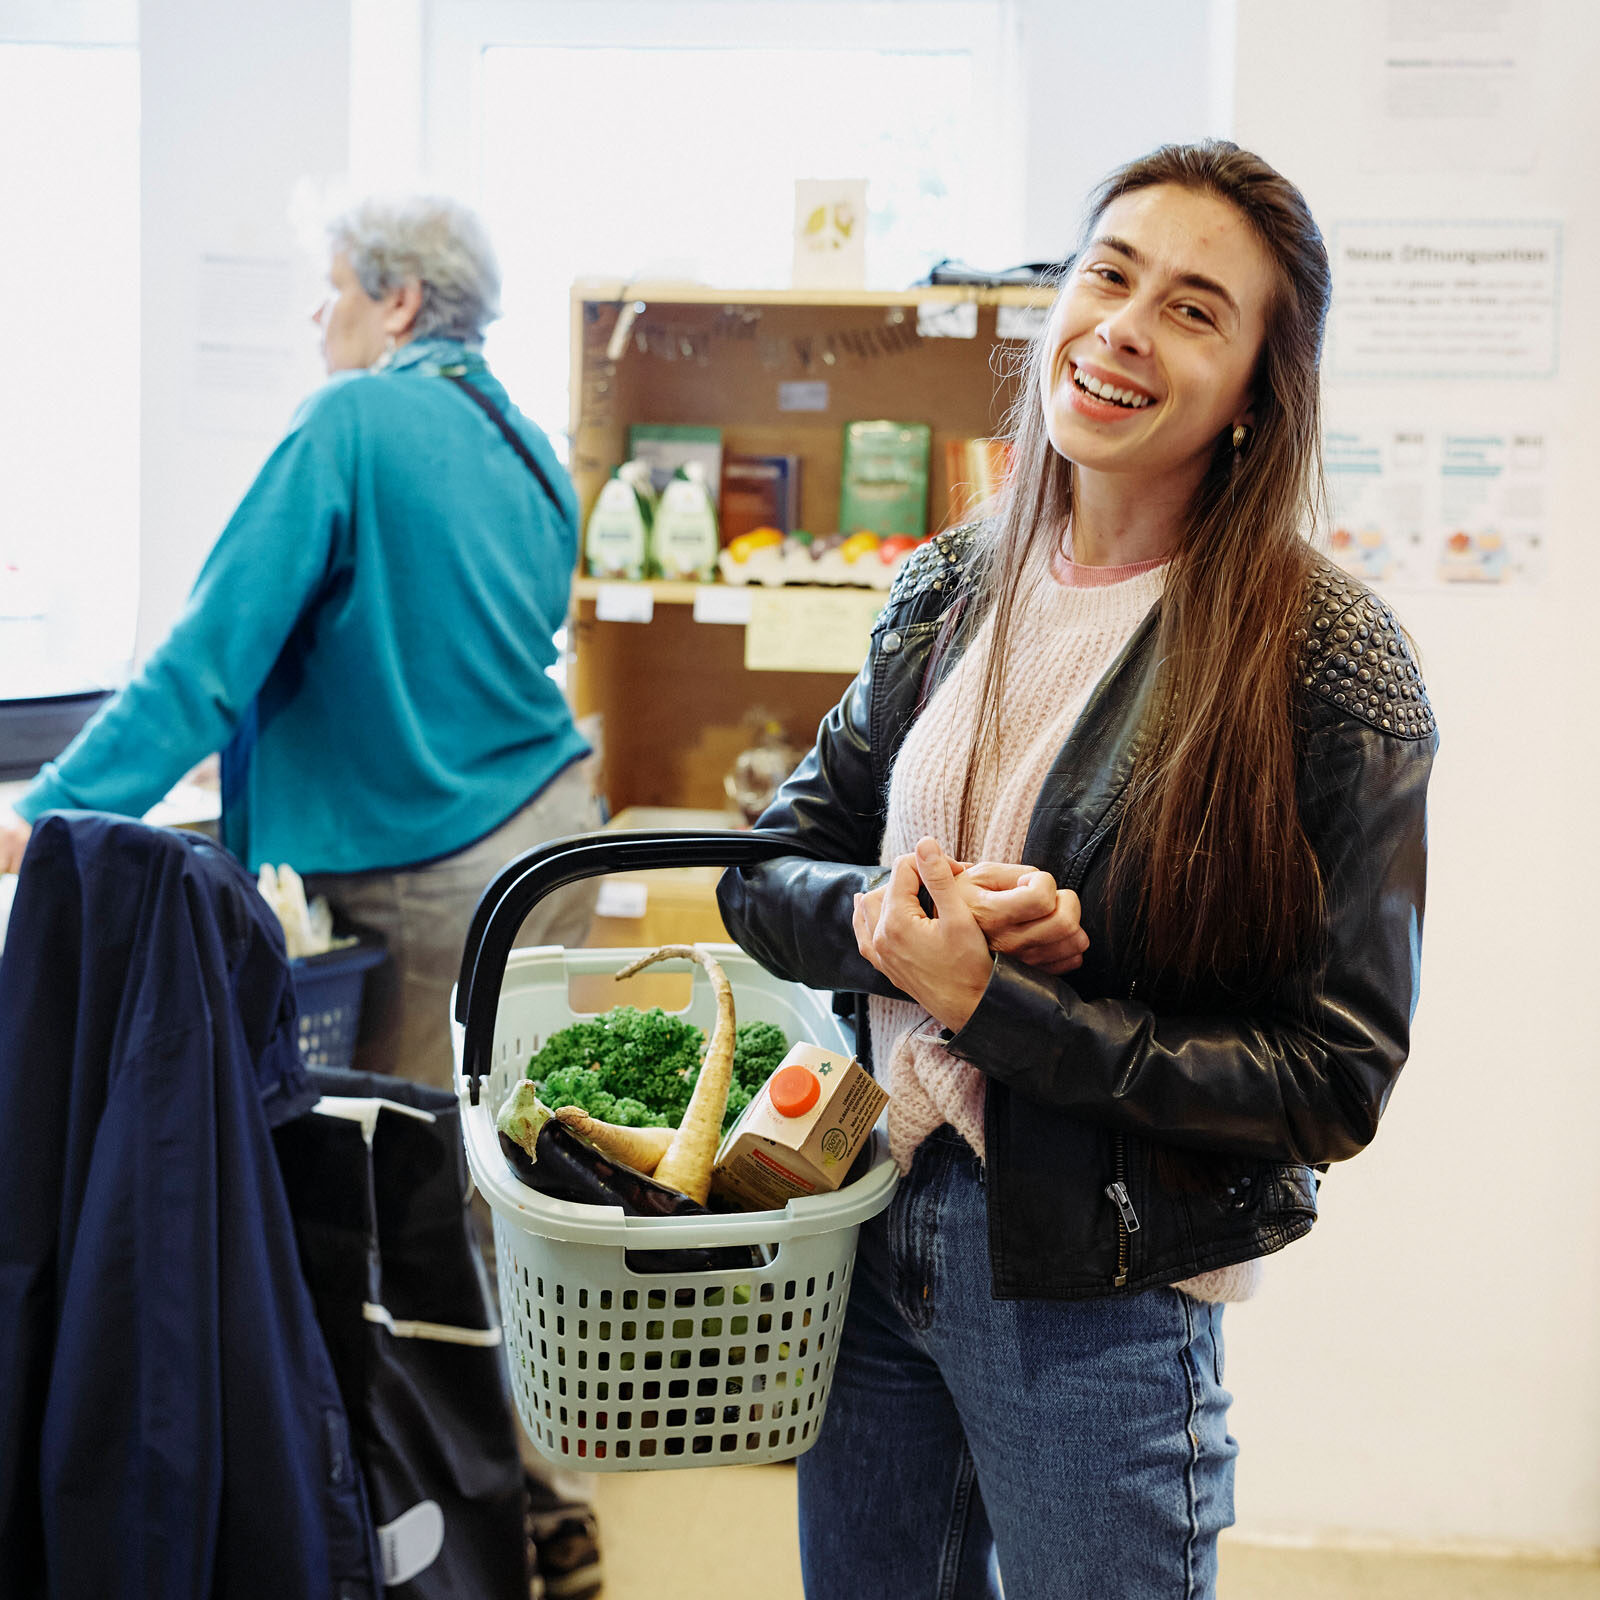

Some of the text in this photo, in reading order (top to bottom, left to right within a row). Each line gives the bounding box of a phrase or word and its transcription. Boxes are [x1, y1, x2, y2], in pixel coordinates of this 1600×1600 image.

[855, 1072, 863, 1084] UND
[851, 1079, 872, 1112] VERPACKUNG
[827, 1133, 840, 1152] 100%
